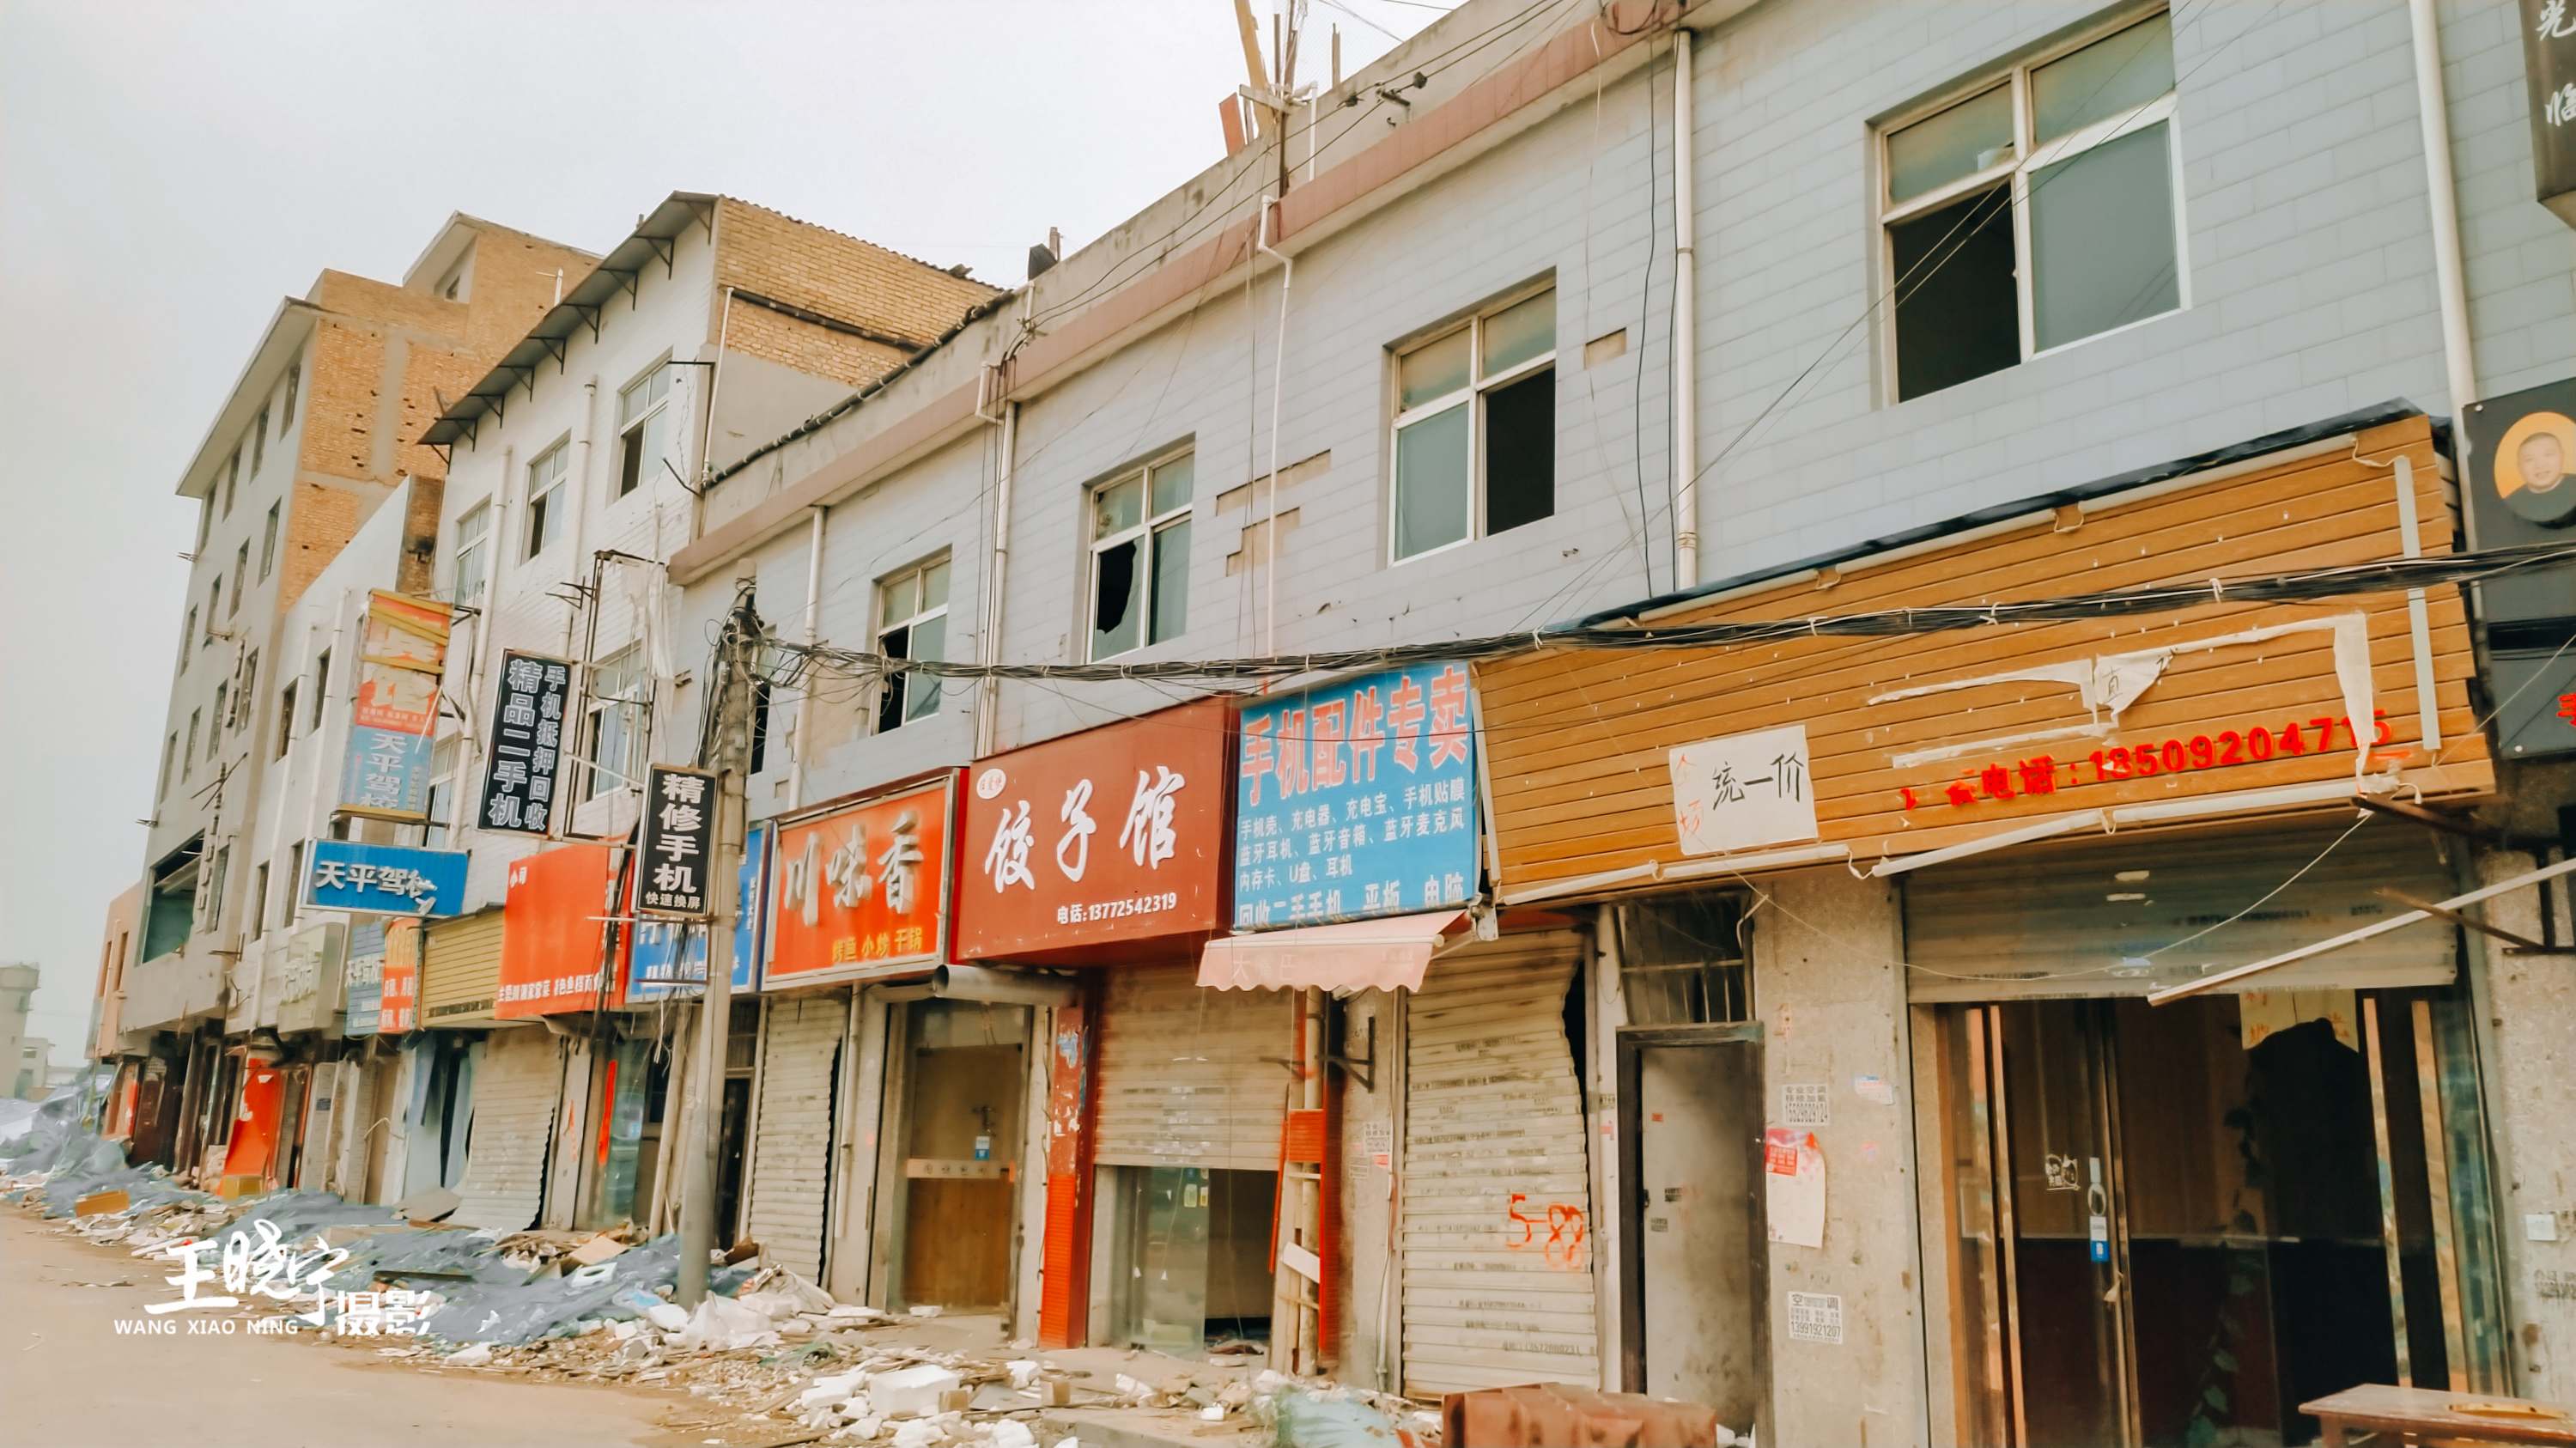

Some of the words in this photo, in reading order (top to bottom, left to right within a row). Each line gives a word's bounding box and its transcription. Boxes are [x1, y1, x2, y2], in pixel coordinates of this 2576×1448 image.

[488, 659, 543, 828] 精品二手机
[524, 666, 567, 830] 手机抵押回收
[1242, 666, 1469, 806] 手机配件专卖
[1712, 751, 1804, 811] 统一价
[653, 774, 705, 894] 精修手机
[784, 809, 924, 927] 川味香
[985, 765, 1185, 893] 饺子馆
[645, 891, 701, 910] 快速换屏
[895, 927, 922, 952] 干锅
